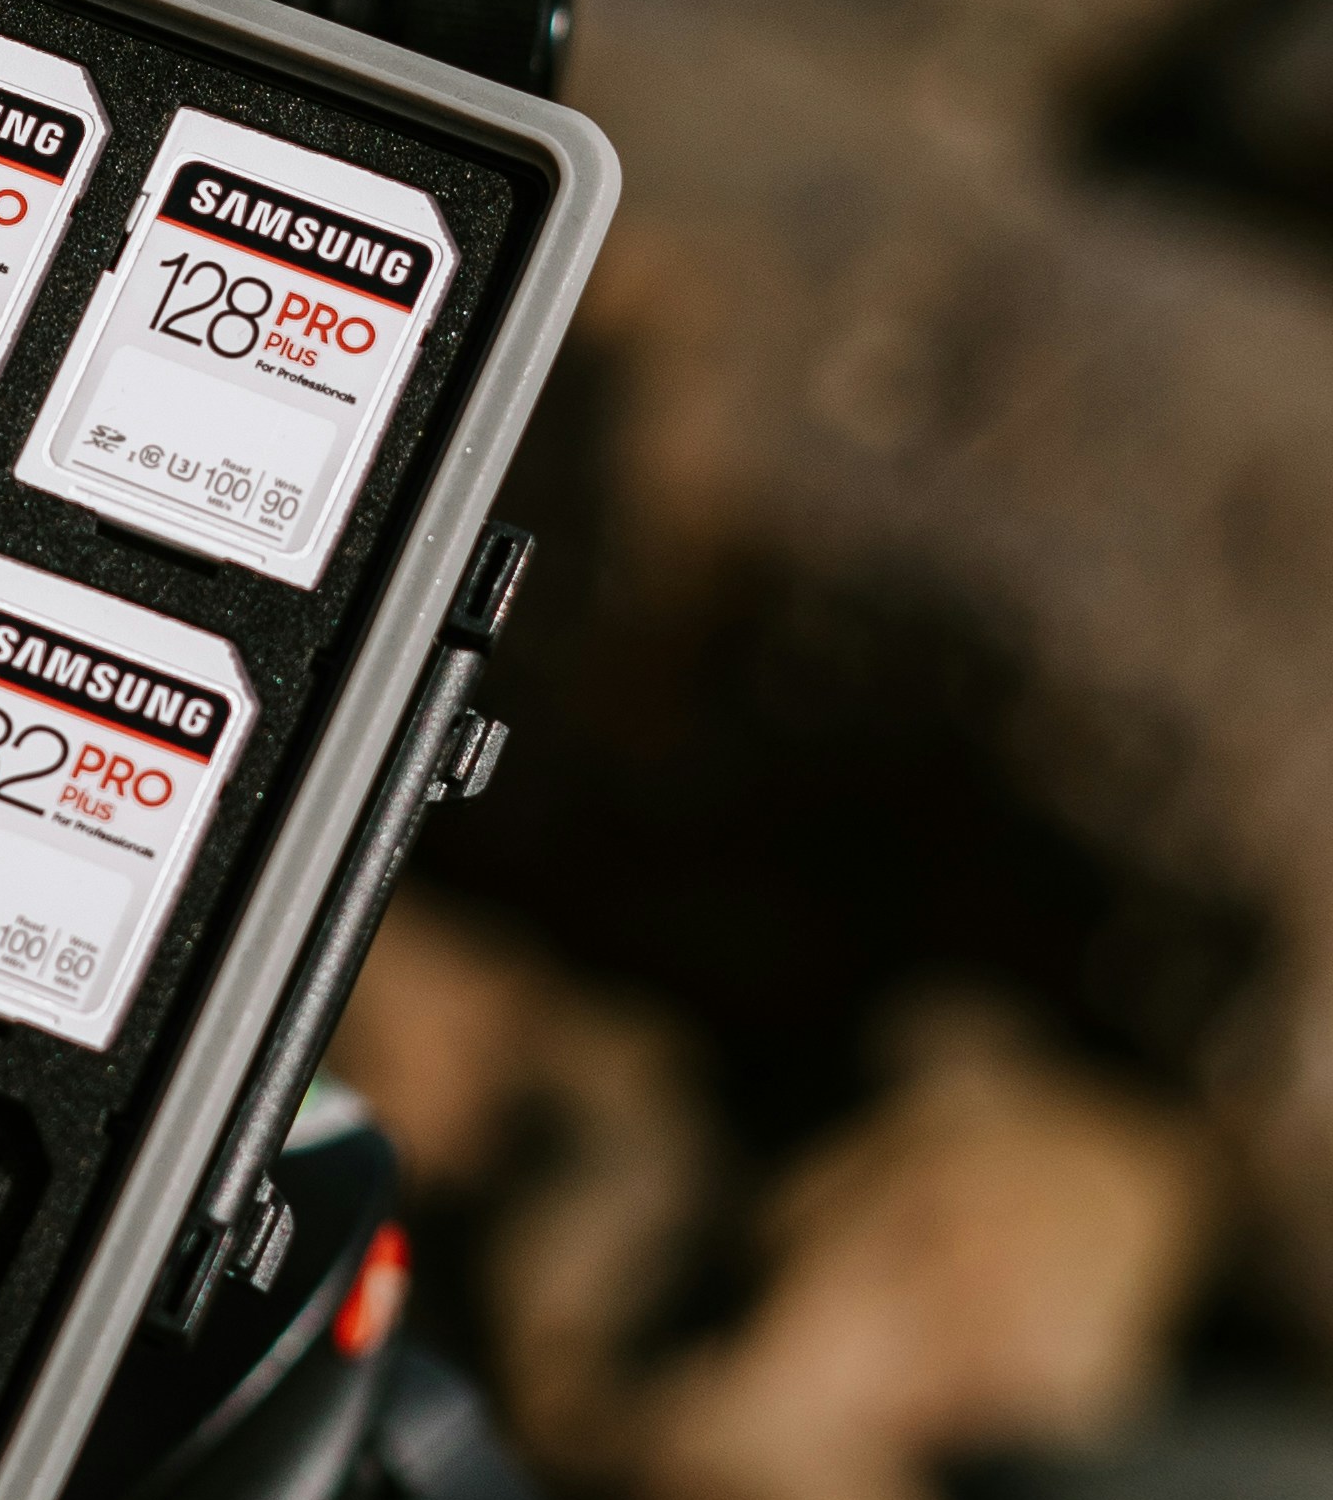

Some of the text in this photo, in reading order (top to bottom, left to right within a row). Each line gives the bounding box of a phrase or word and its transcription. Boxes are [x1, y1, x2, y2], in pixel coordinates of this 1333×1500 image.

[190, 178, 415, 286] SAMSUNG
[148, 252, 377, 359] 128 PRO
[263, 331, 318, 367] Plus
[255, 359, 357, 404] For Professionals
[204, 467, 252, 503] 100
[260, 489, 299, 521] 90
[221, 458, 303, 495] Read Write
[71, 743, 174, 808] PRO
[59, 785, 114, 821] Plus
[0, 925, 47, 961] 100
[55, 947, 95, 980] 60
